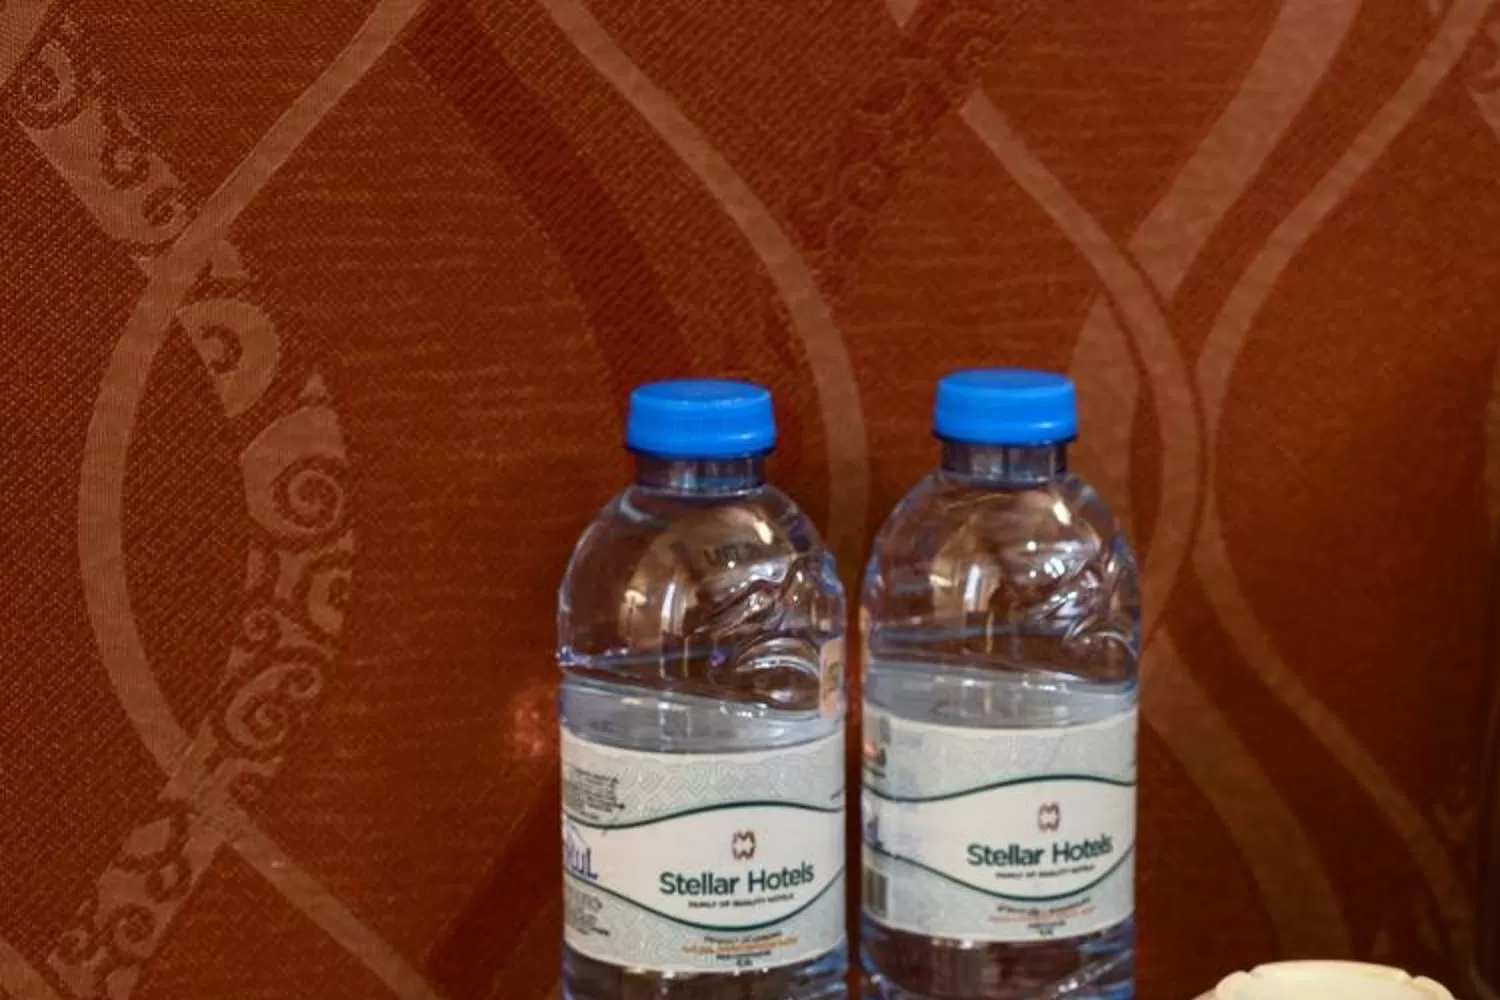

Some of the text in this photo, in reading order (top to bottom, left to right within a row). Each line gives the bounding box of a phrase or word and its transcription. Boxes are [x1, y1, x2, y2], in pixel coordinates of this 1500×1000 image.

[967, 833, 1113, 866] Stellar Hotels
[659, 861, 815, 896] Stellar Hotels
